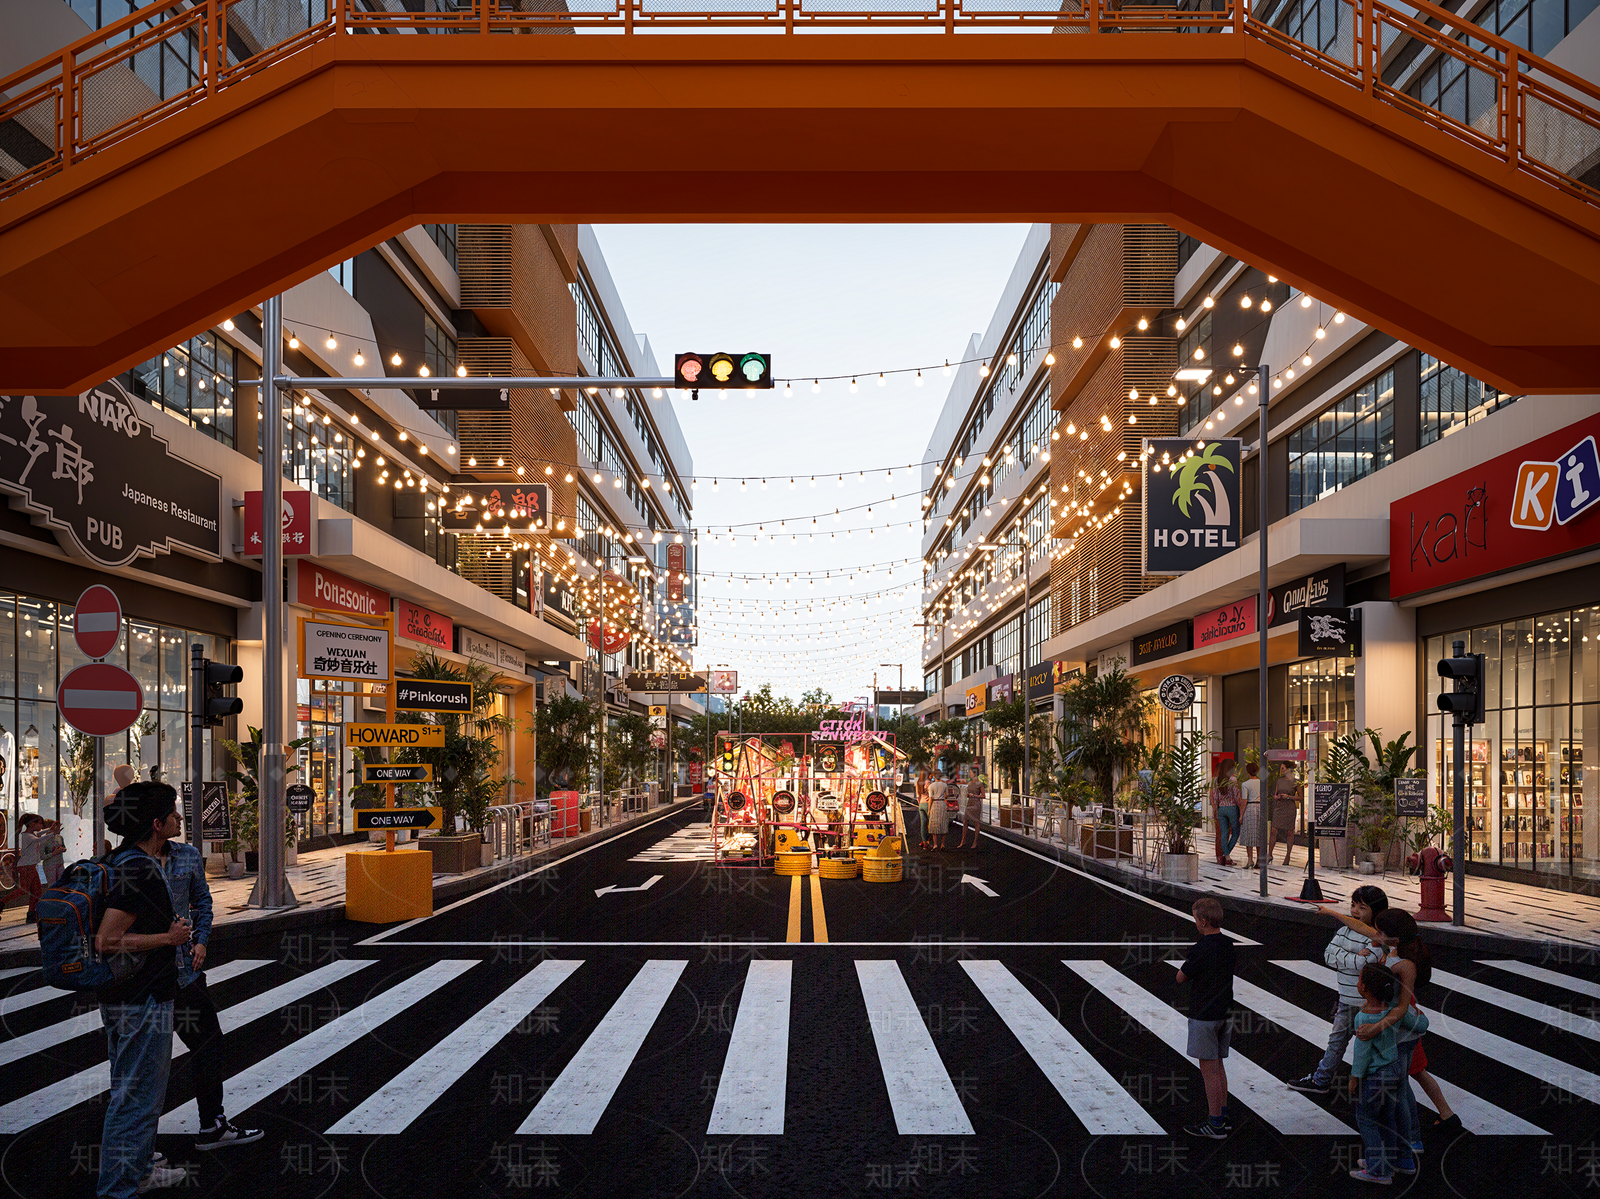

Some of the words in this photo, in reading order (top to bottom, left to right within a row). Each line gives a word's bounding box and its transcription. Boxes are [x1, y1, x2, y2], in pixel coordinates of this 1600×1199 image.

[122, 483, 168, 513] Japanese
[171, 501, 217, 532] Restaurant
[87, 516, 123, 550] PUB
[1153, 528, 1236, 548] HOTEL
[398, 689, 468, 704] #Pinkorush
[350, 728, 420, 743] HOWARD
[376, 769, 393, 778] ONE
[394, 769, 412, 778] WAY
[371, 816, 391, 825] ONE
[393, 815, 415, 825] WAY
